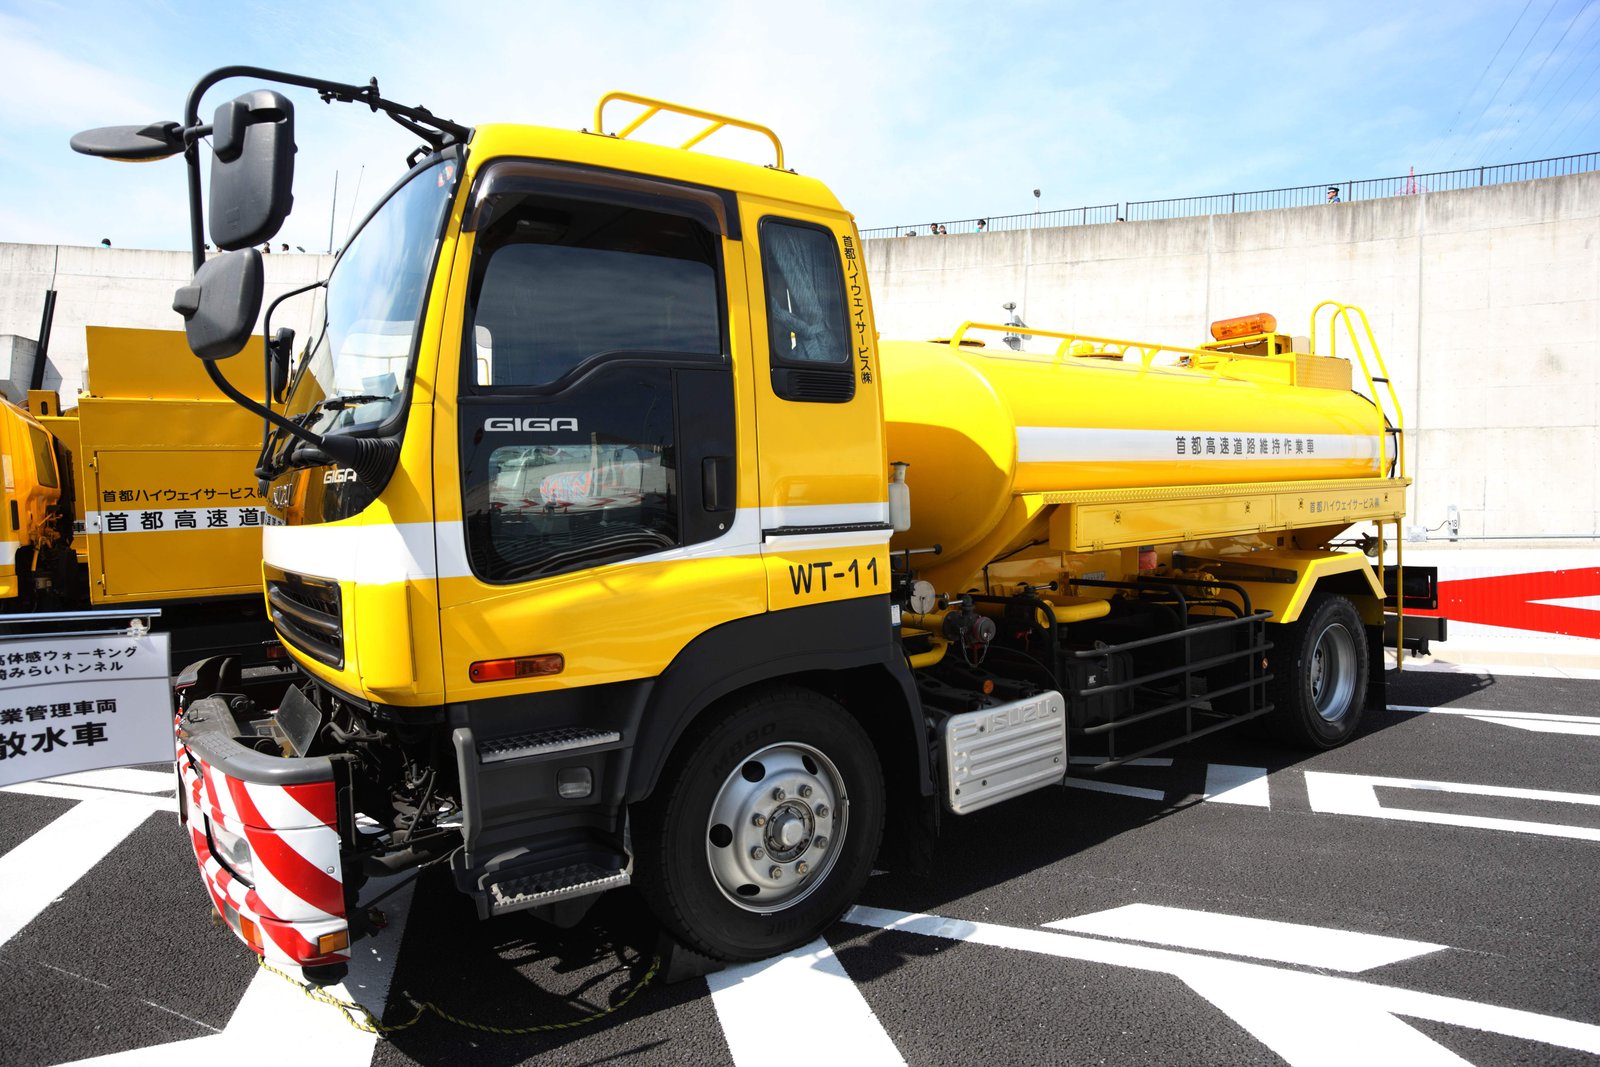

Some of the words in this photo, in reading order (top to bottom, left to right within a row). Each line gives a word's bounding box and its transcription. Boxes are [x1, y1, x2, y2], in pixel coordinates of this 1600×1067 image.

[484, 417, 578, 432] GIGA
[1175, 436, 1315, 455] 首都高速道路維持作業車
[323, 468, 357, 484] GIGA
[788, 557, 878, 595] WT-11
[0, 698, 117, 725] 業管理車両
[985, 700, 1051, 734] ISUZU
